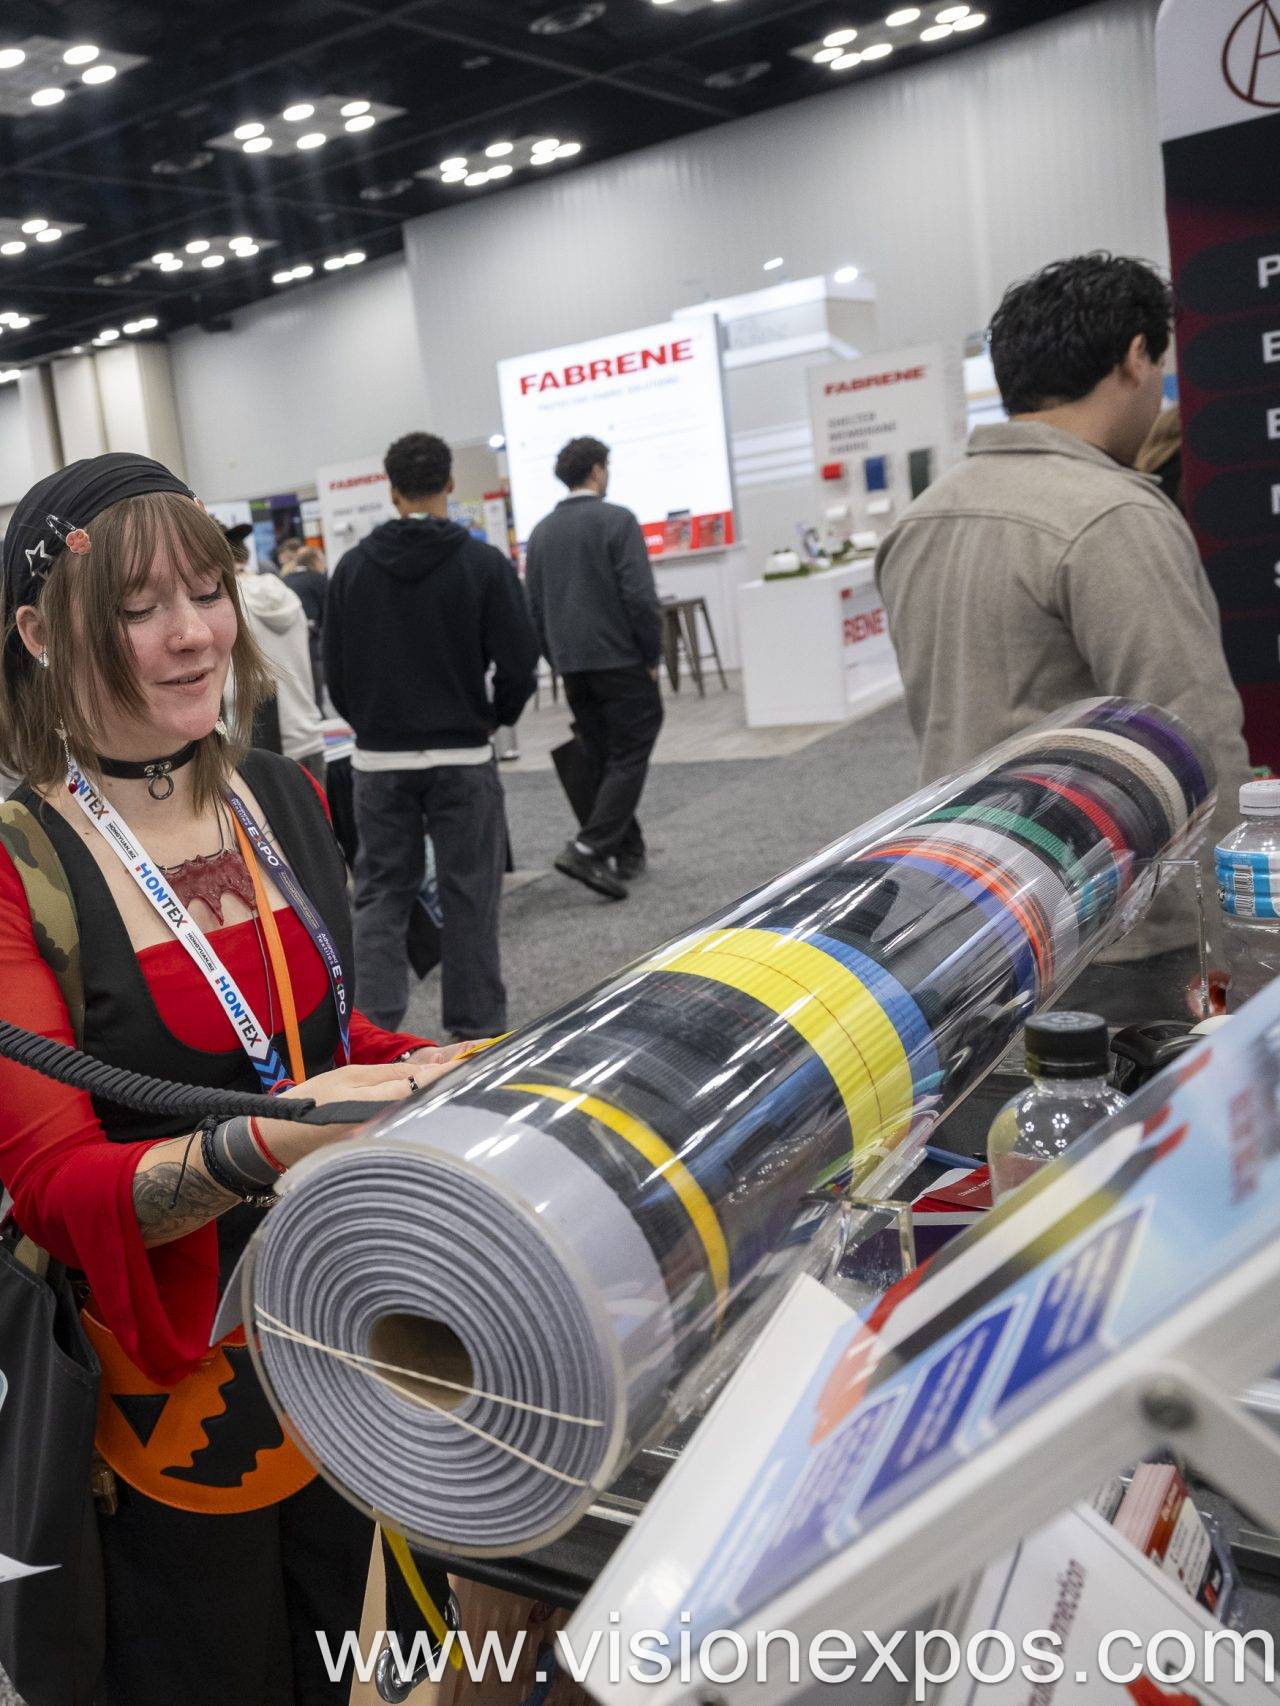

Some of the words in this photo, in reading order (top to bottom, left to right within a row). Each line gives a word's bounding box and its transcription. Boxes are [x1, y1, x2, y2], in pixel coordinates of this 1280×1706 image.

[519, 338, 694, 396] FABRENE
[823, 364, 927, 398] FABRENE
[70, 763, 109, 821] ONTEX
[135, 862, 188, 929] HONTEX
[215, 975, 262, 1048] HONTEX
